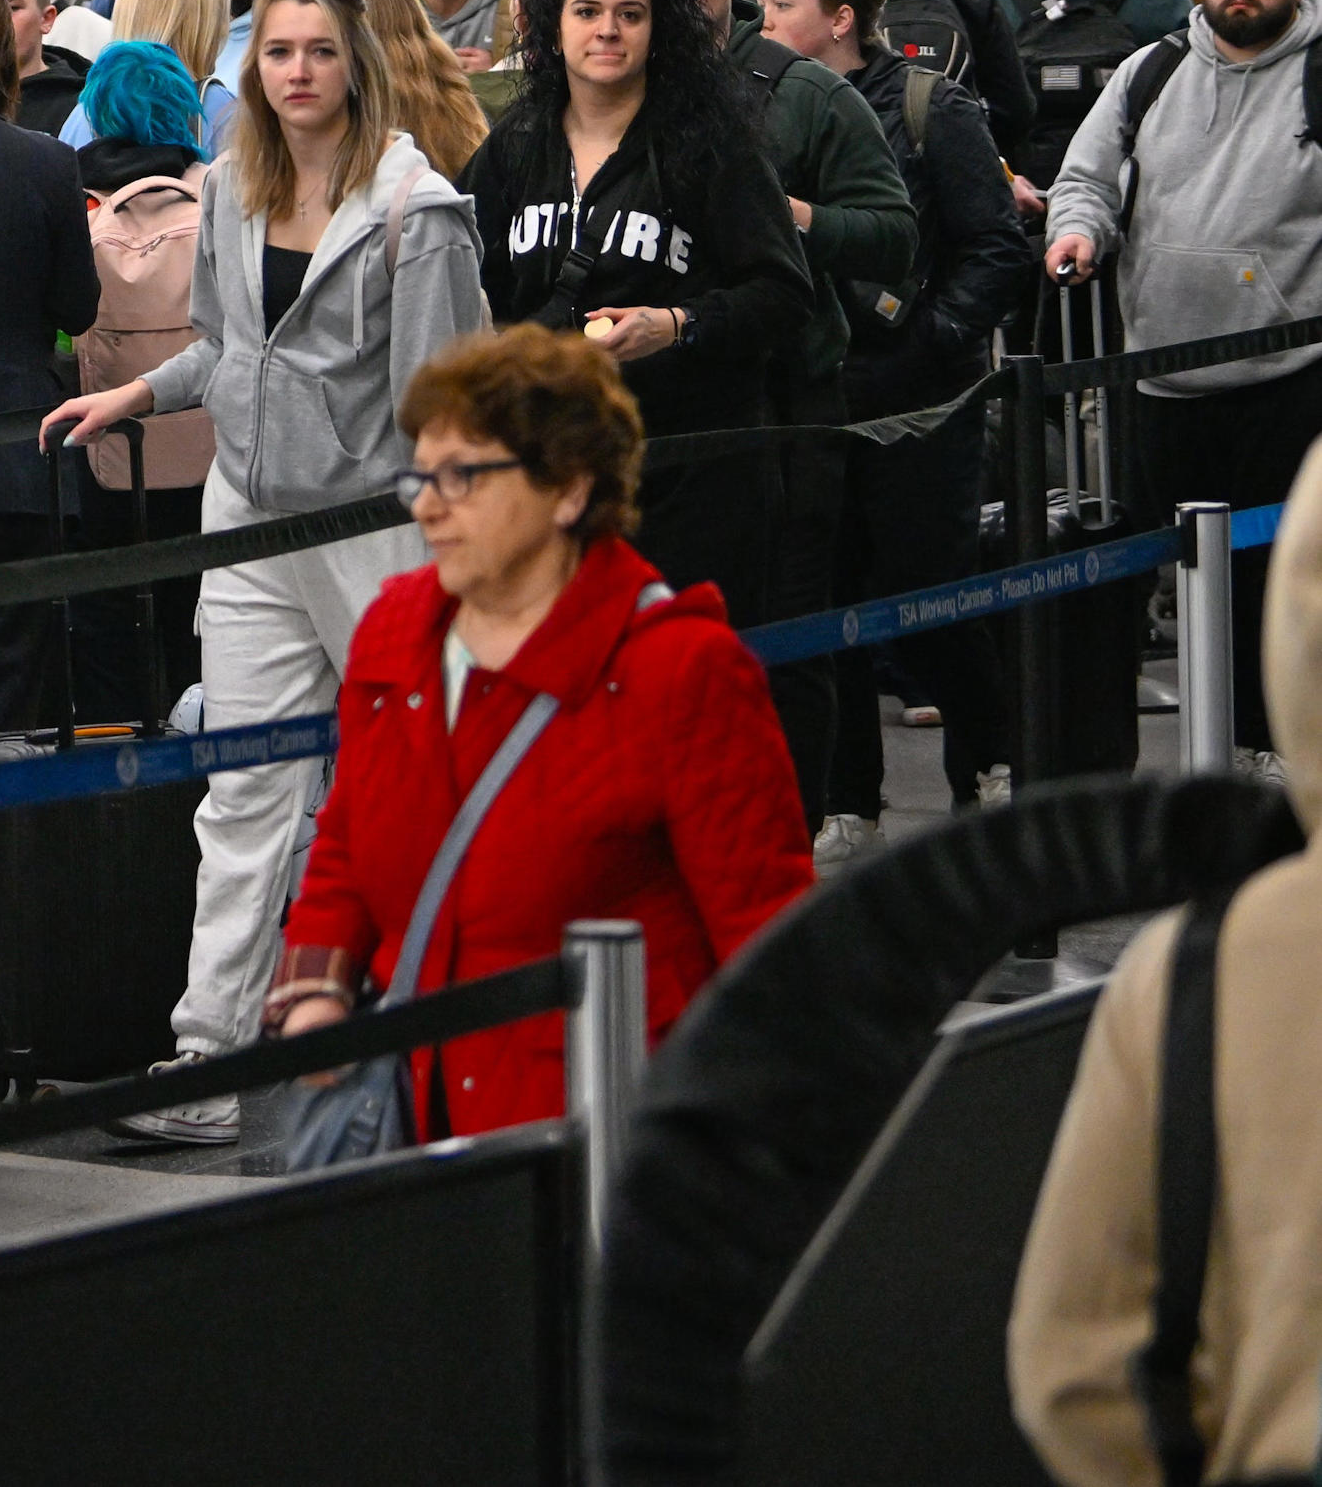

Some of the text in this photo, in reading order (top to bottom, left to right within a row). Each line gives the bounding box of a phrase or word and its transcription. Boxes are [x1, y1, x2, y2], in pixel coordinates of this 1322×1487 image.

[898, 604, 918, 628] TSA
[918, 596, 957, 621] Working
[958, 587, 994, 612] Canines
[1002, 577, 1031, 601] Please
[1032, 573, 1046, 594] Do
[1046, 568, 1063, 591] Not
[1063, 563, 1079, 587] Pet
